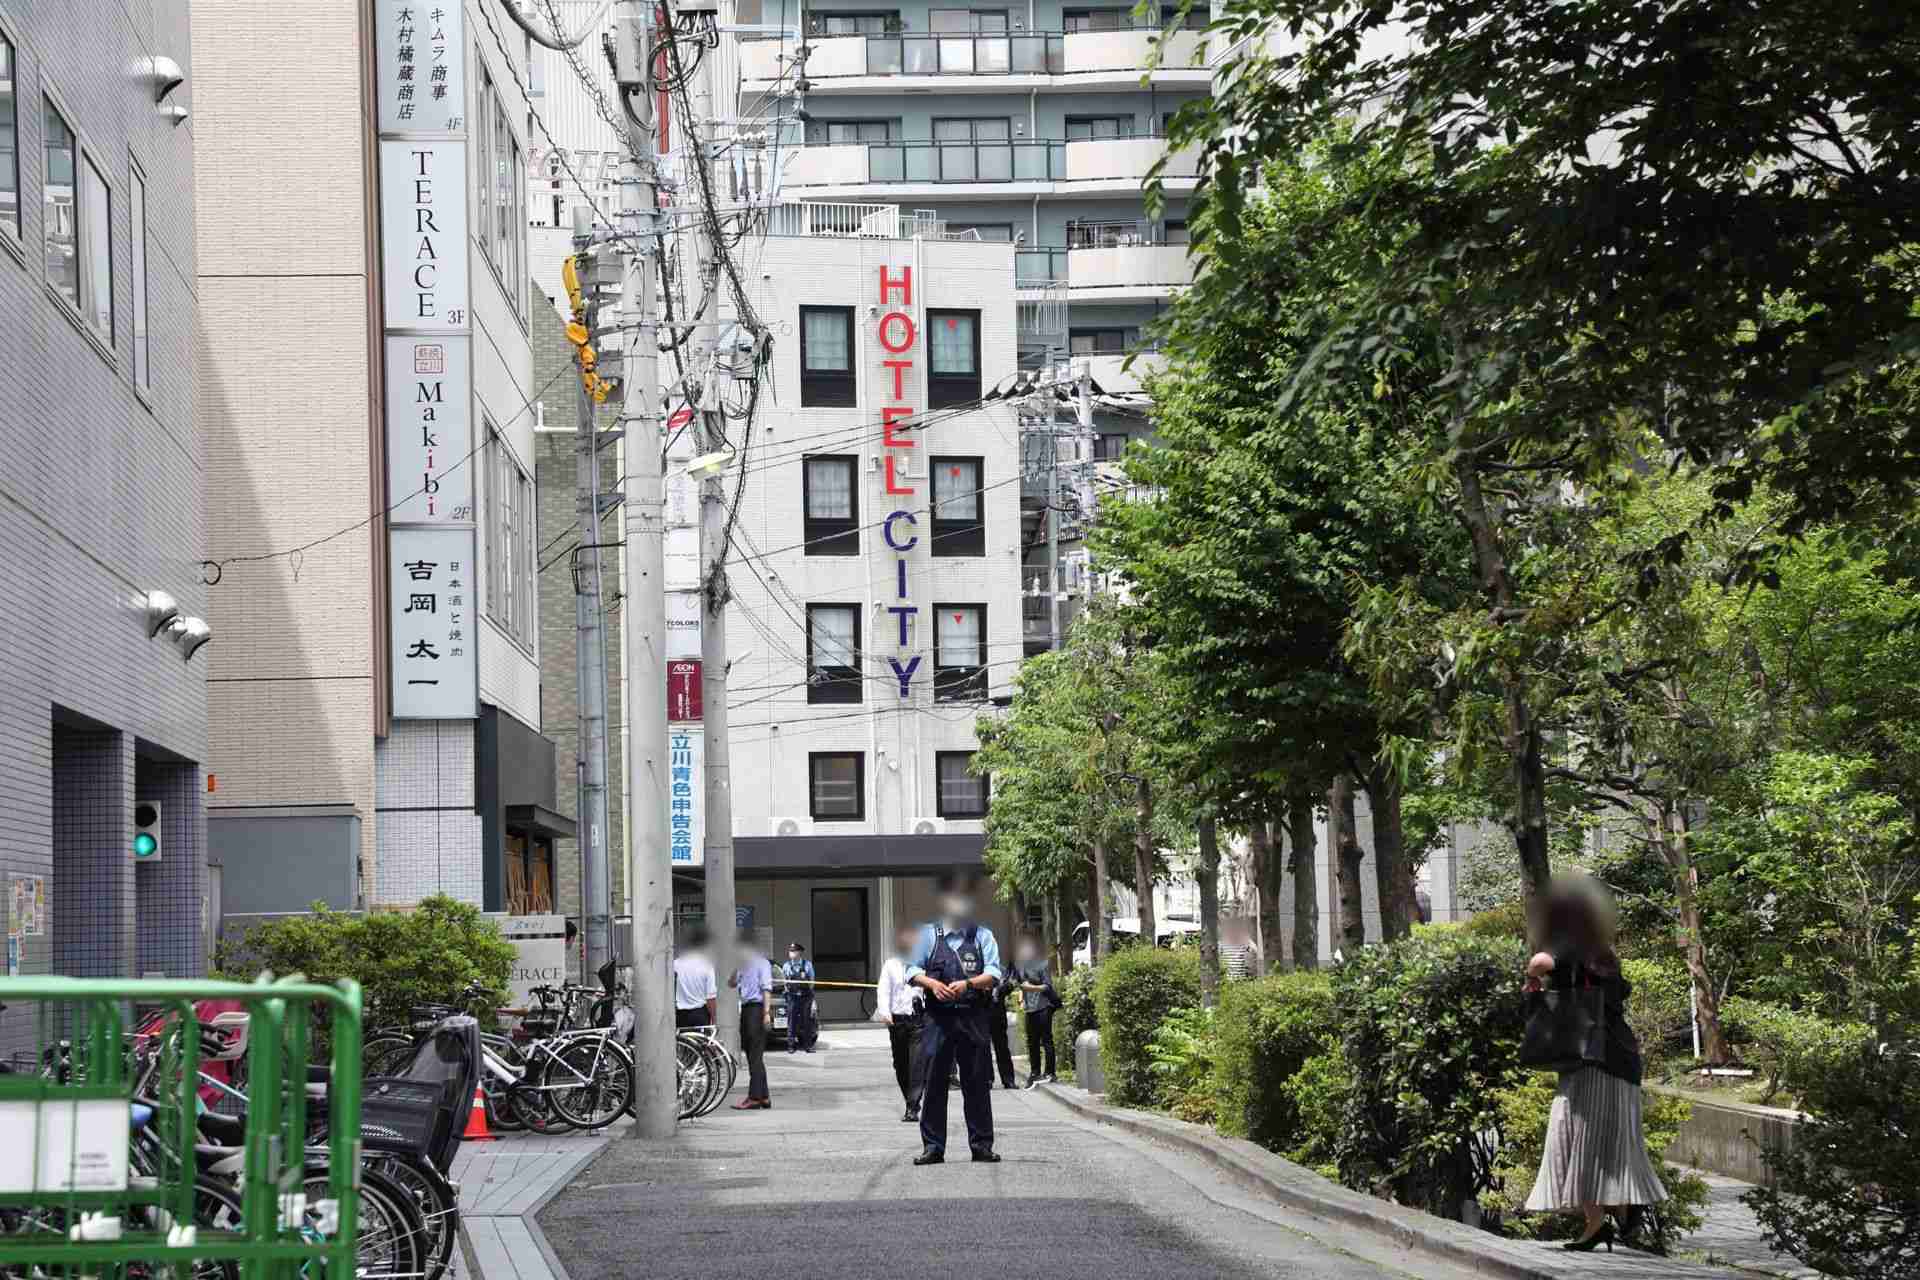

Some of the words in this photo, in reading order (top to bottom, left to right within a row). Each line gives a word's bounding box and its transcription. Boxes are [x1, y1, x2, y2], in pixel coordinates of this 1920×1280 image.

[430, 7, 448, 101] キムラ商事
[411, 151, 440, 318] TERACE
[448, 310, 465, 324] 3F
[878, 265, 915, 495] HOTEL
[416, 382, 443, 516] Makibi
[451, 506, 471, 520] 2F
[403, 559, 440, 686] 吉岡太一
[883, 510, 921, 698] CITY
[511, 967, 560, 980] ERACE
